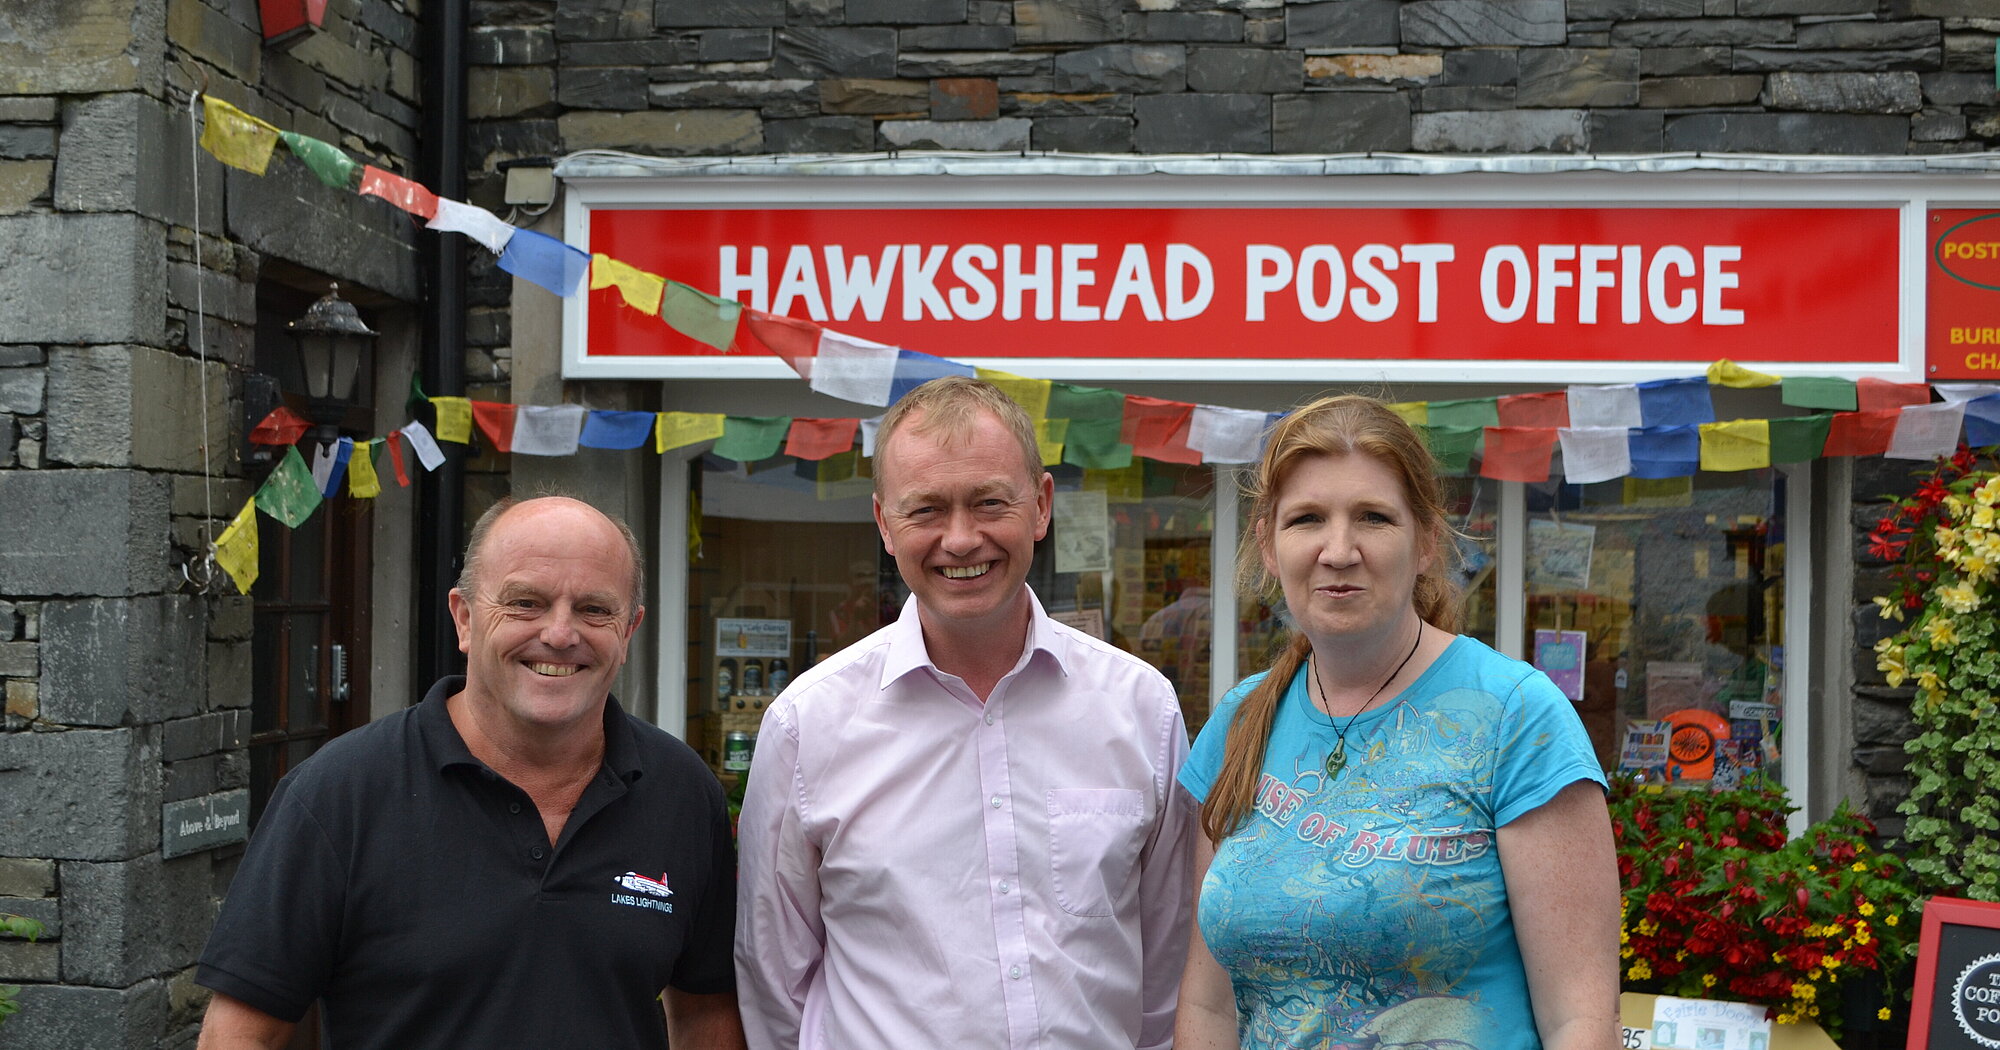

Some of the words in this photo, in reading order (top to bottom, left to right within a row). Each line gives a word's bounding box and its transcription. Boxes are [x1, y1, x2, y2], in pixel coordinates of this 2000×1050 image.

[1944, 242, 2000, 259] POST
[719, 243, 1214, 321] HAWKSHEAD
[1245, 243, 1455, 322] POST
[1480, 244, 1745, 325] OFFICE
[1965, 352, 2000, 370] CH
[179, 820, 203, 837] Above
[214, 809, 240, 831] Beyond
[1253, 773, 1303, 829] USE
[1297, 812, 1347, 848] OF
[1342, 830, 1491, 868] BLUES
[611, 893, 635, 906] LAKES
[636, 897, 673, 914] LIGHTNINGS
[1976, 1006, 2000, 1023] PO
